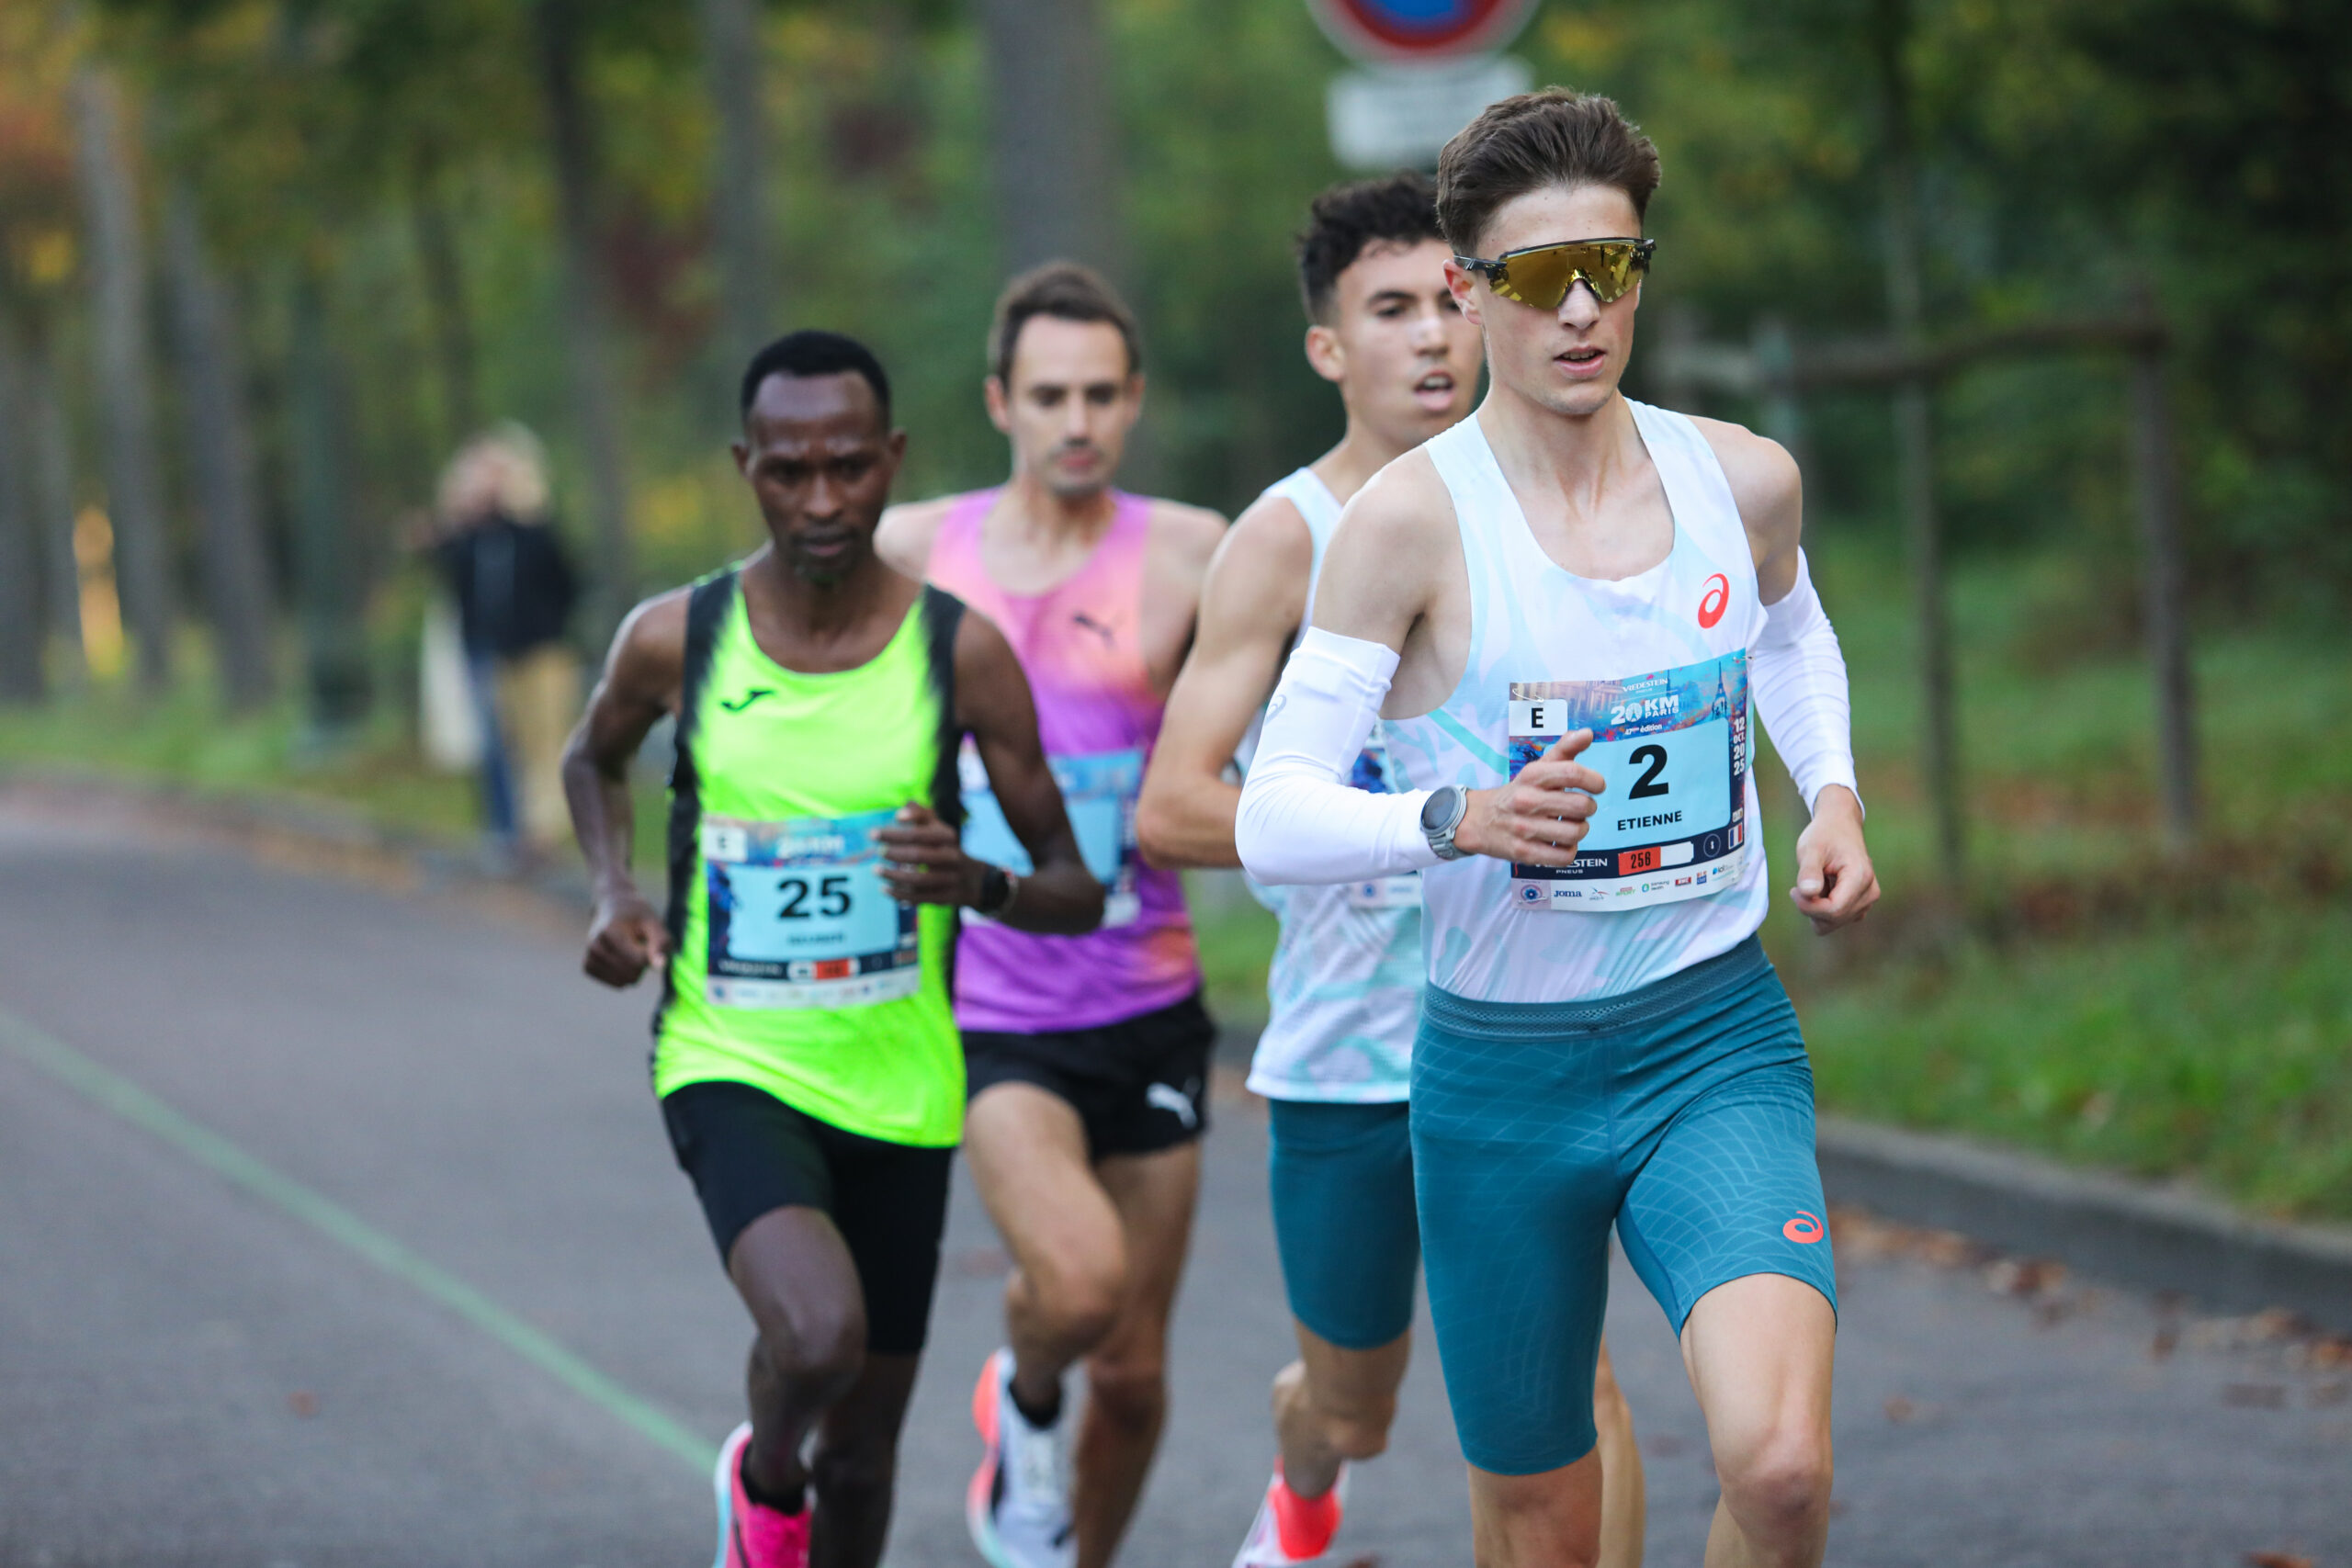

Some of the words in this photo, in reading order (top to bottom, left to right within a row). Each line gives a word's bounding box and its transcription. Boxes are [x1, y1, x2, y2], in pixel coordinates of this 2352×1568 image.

[1532, 707, 1544, 728] E
[1611, 703, 1643, 726] 20
[1645, 694, 1679, 712] KM
[1645, 706, 1679, 718] PARIS
[1734, 716, 1745, 733] 12
[1734, 742, 1745, 760] 20
[1628, 744, 1669, 800] 2
[1734, 758, 1745, 775] 25
[1617, 810, 1683, 831] ETIENNE
[777, 875, 851, 919] 25
